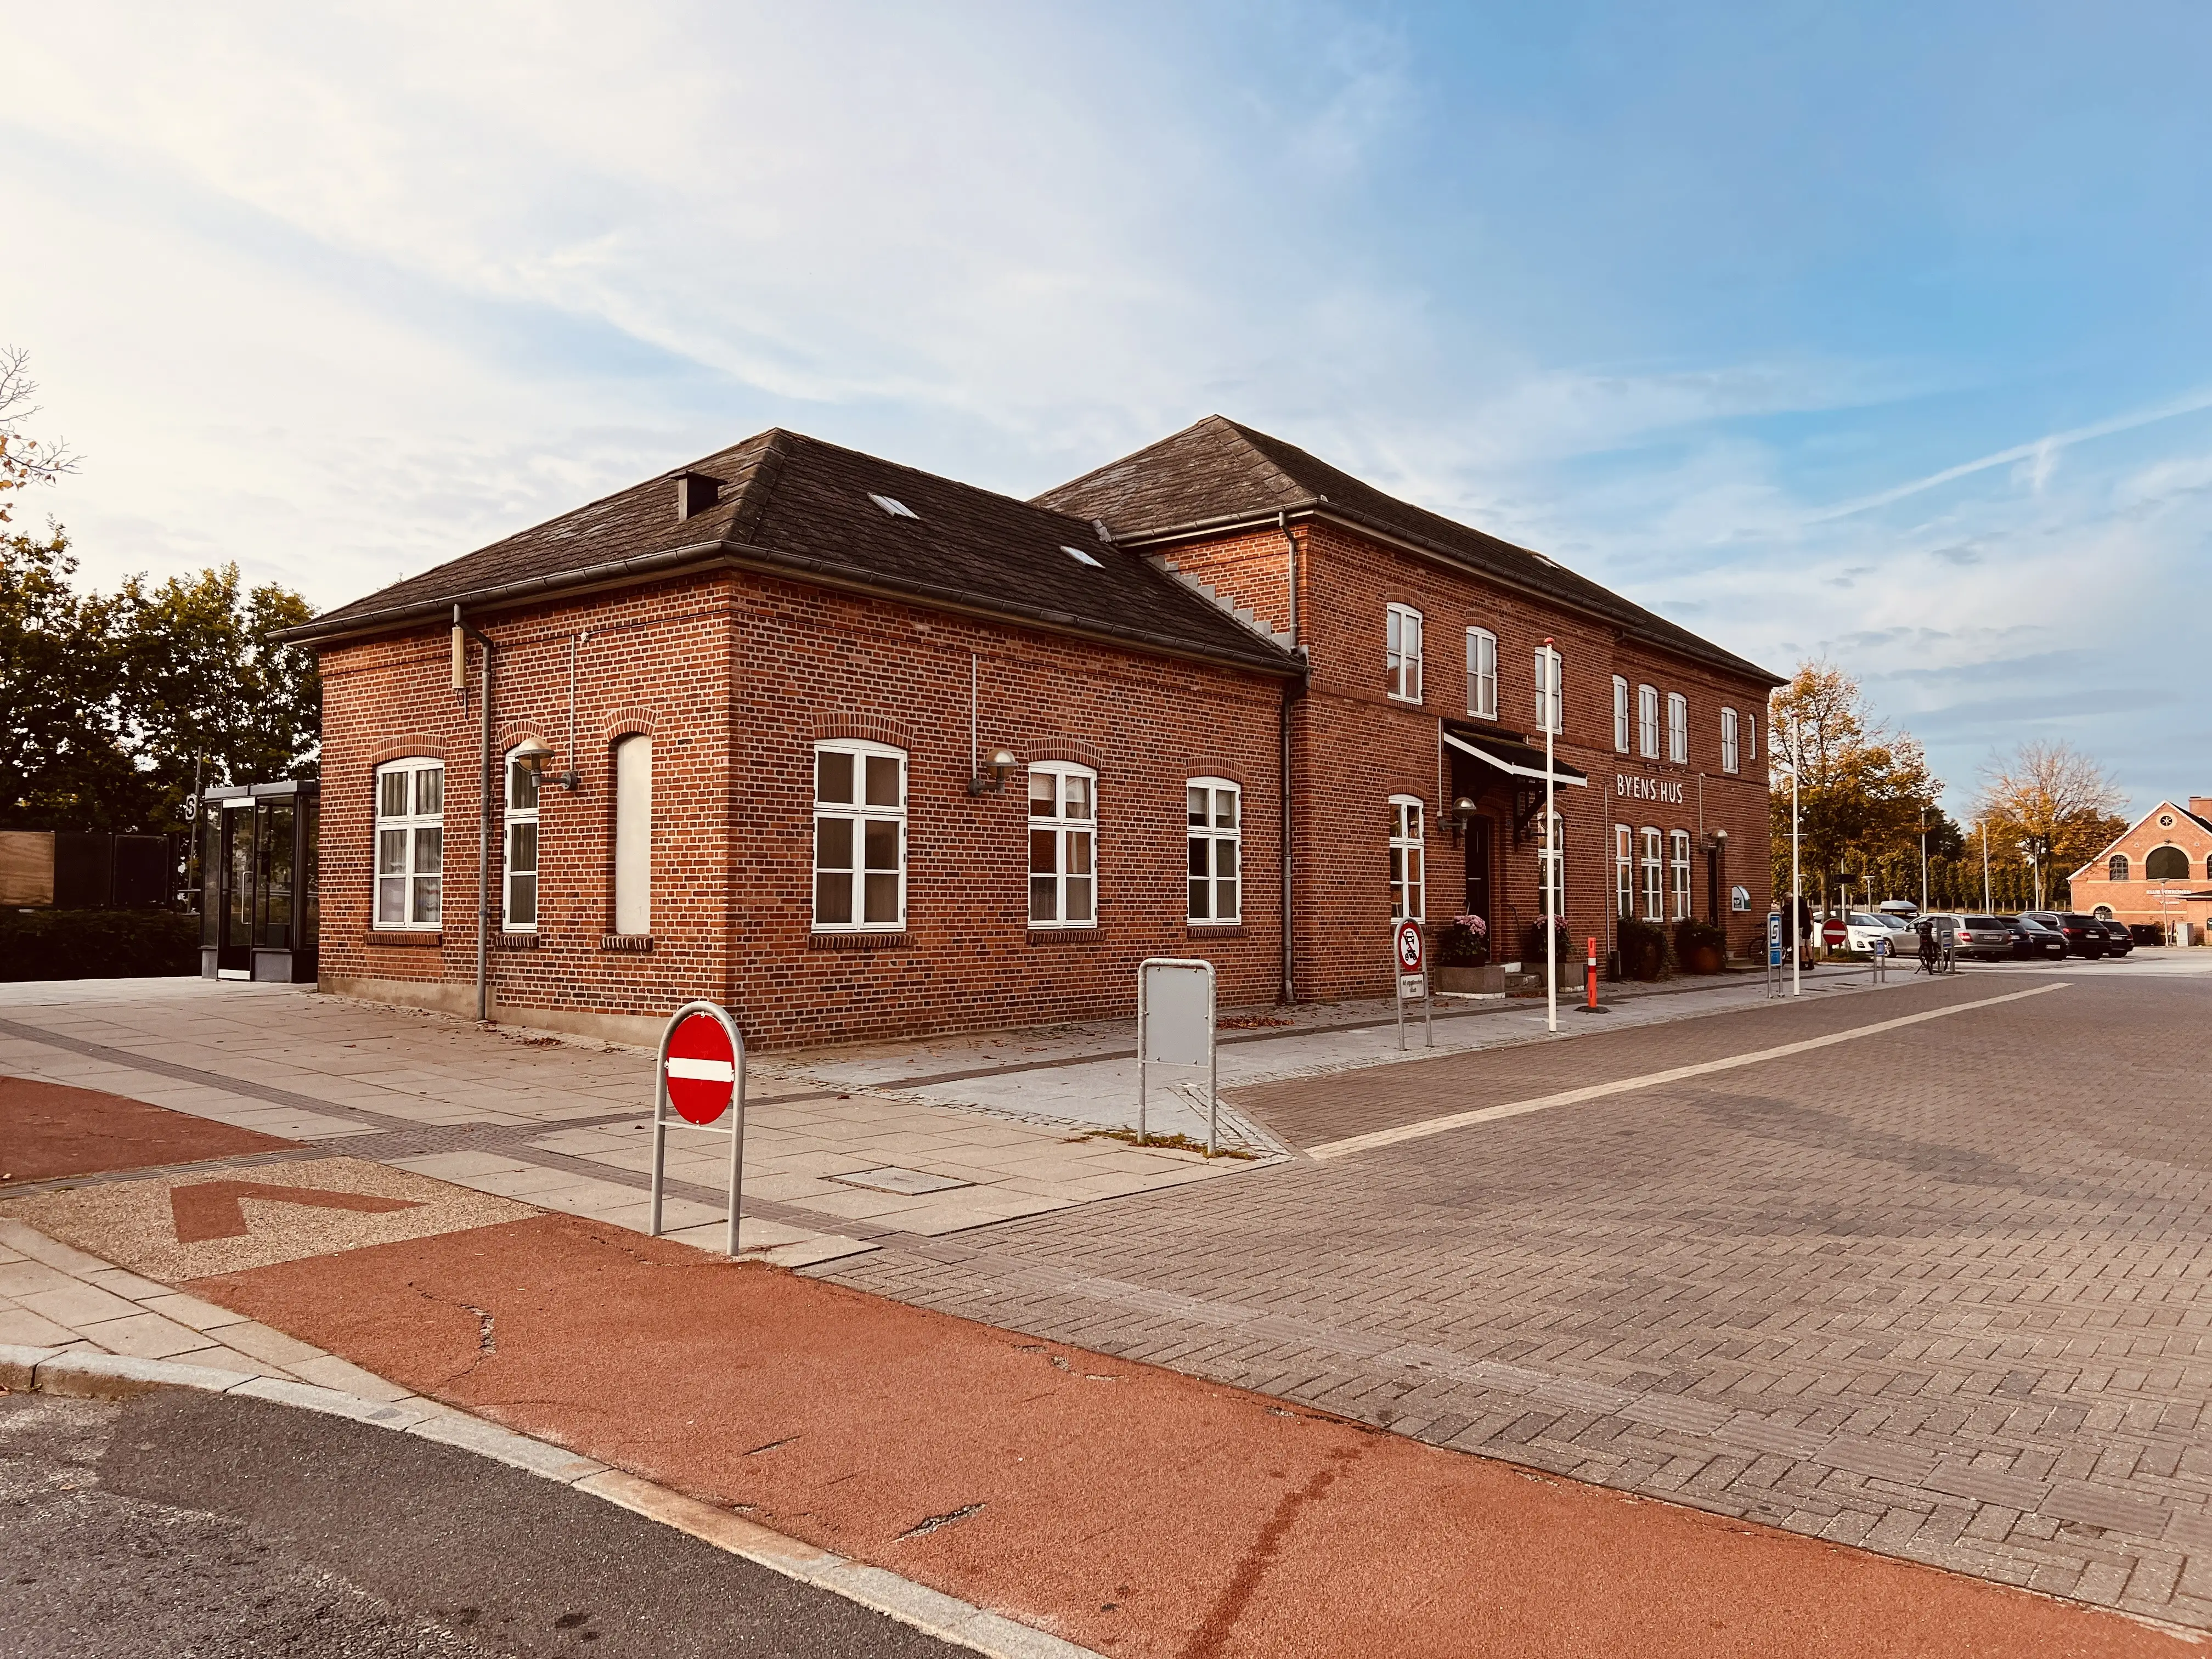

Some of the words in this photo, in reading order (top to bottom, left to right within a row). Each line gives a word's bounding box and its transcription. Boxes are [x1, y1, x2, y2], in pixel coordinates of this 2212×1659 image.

[1617, 774, 1656, 800] BYENS
[1660, 782, 1683, 804] HUS
[187, 798, 195, 817] S
